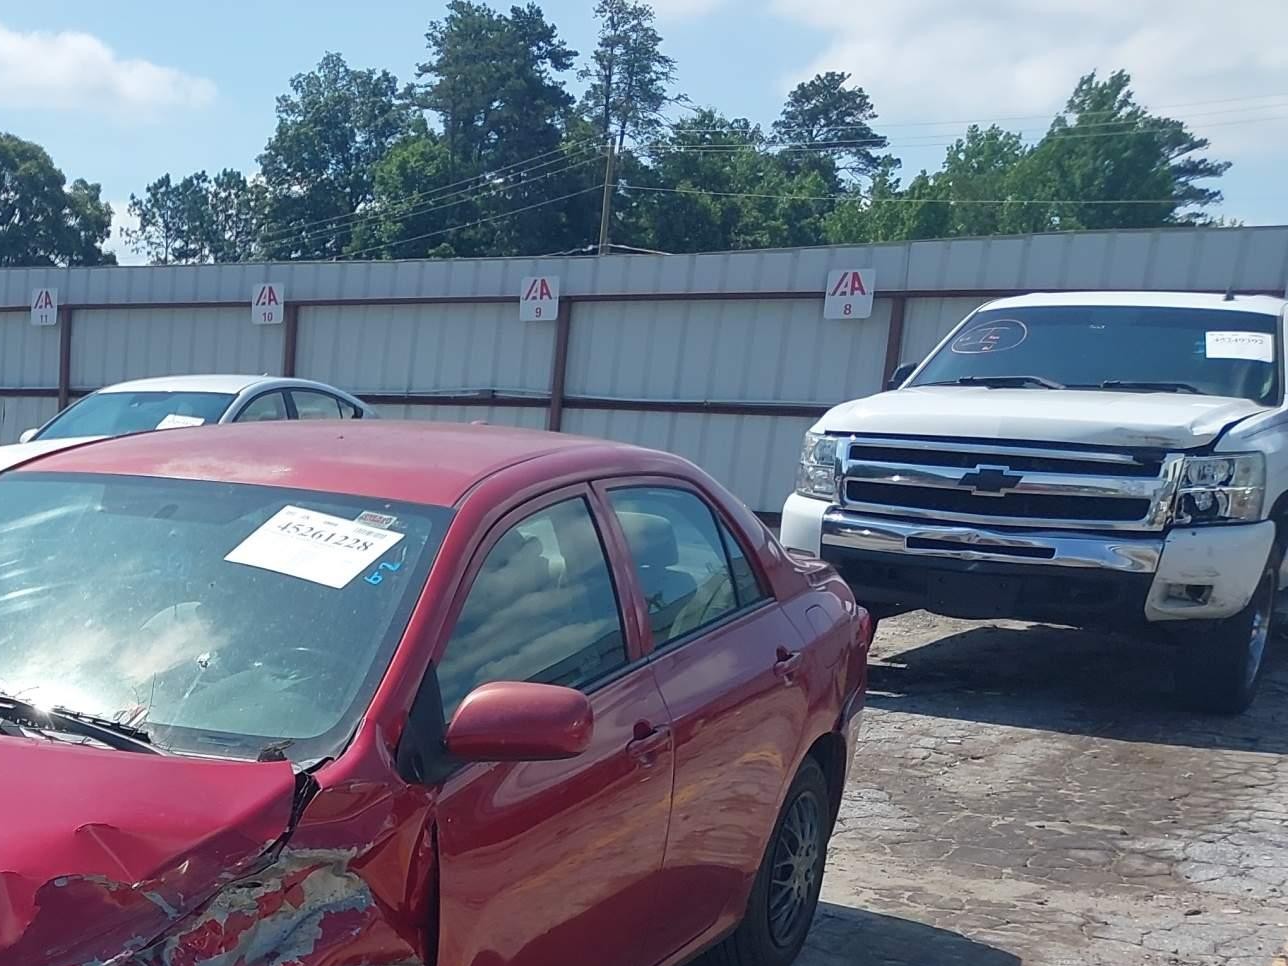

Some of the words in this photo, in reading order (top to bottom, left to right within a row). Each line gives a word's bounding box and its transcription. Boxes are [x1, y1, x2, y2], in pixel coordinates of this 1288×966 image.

[535, 306, 542, 318] 9
[843, 303, 853, 316] 8
[40, 314, 48, 324] 11
[262, 311, 274, 322] 10
[277, 521, 374, 552] 45261228
